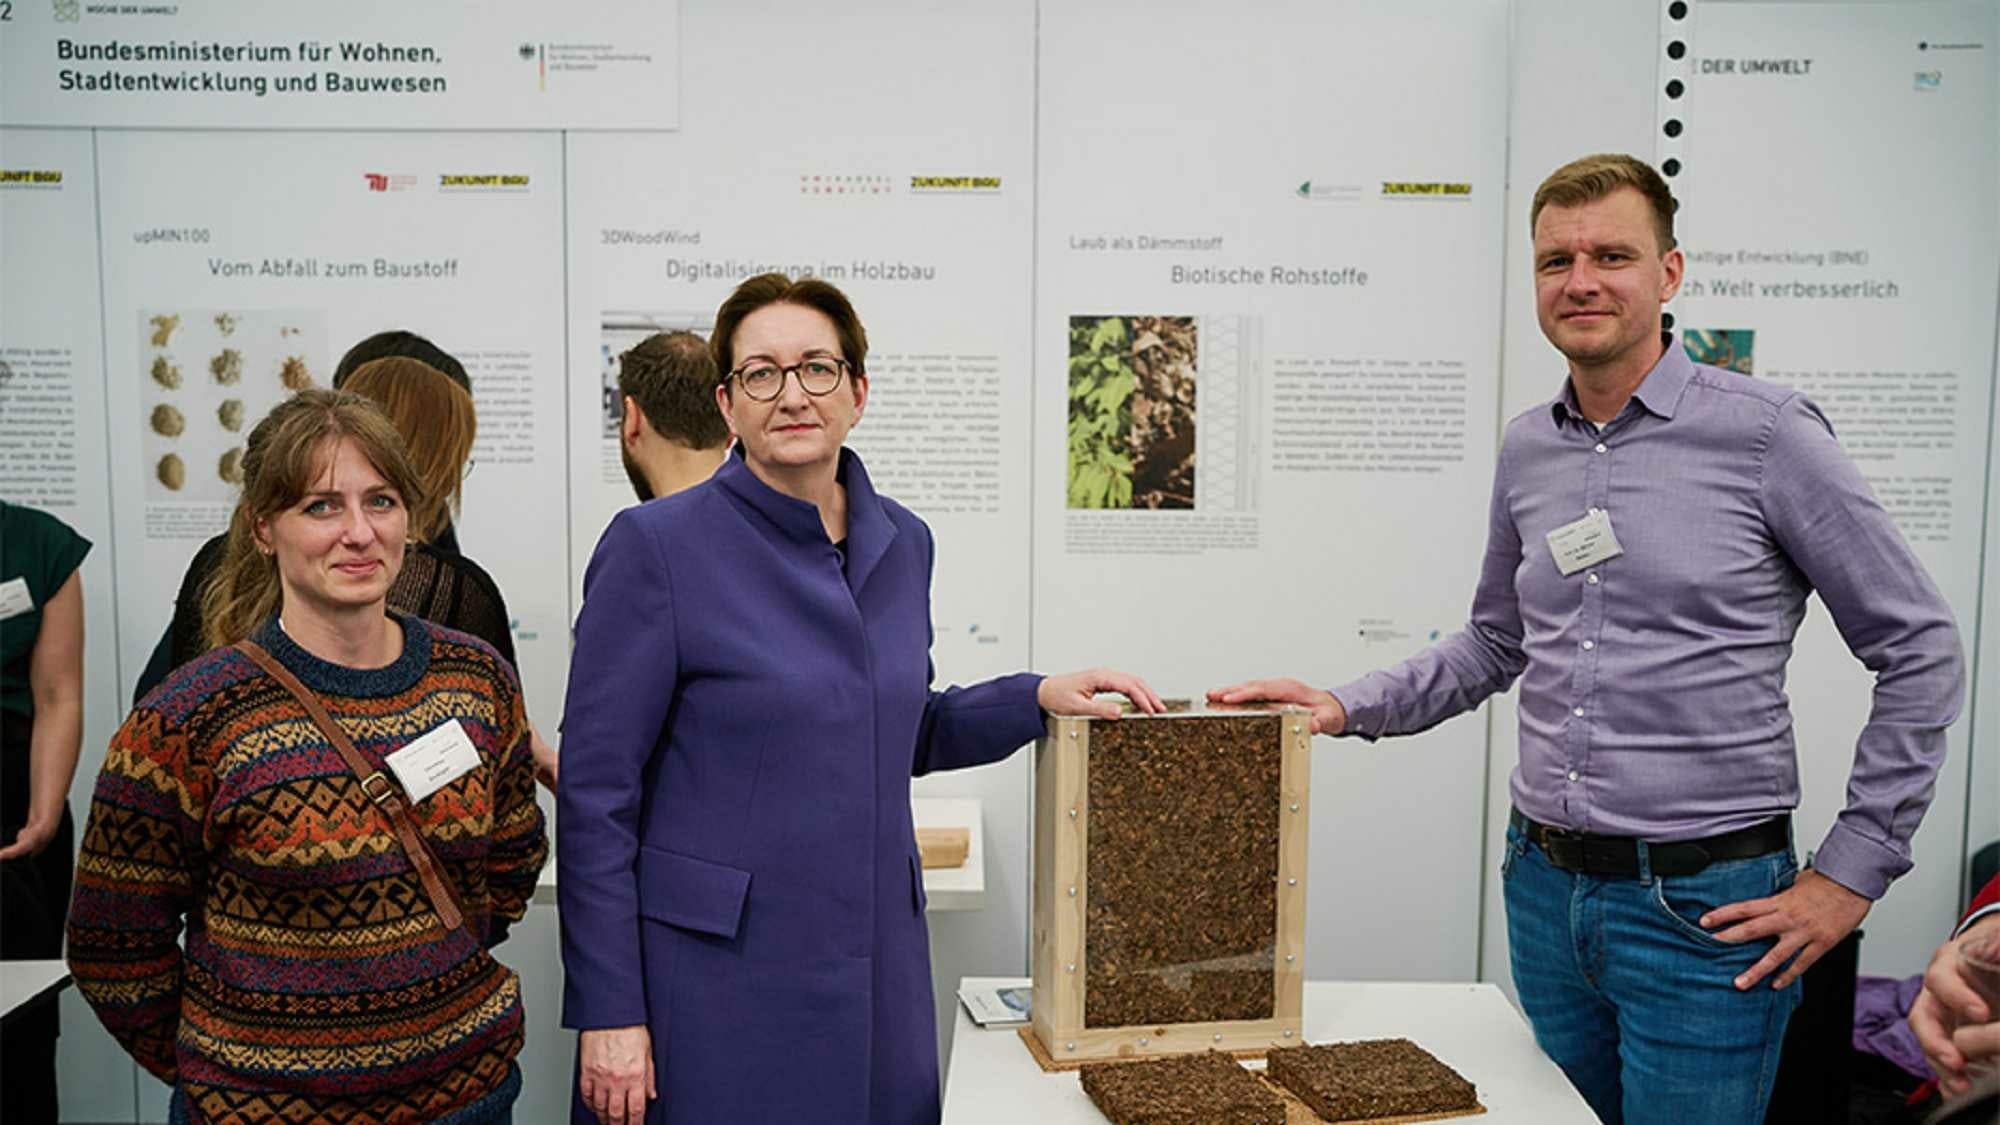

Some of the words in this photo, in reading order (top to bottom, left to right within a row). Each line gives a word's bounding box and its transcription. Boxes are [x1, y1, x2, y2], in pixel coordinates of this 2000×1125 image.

[57, 39, 291, 62] Bundesministerium
[298, 41, 332, 62] für
[339, 42, 442, 64] Wohnen,
[1702, 59, 1735, 74] DER
[1741, 59, 1812, 75] UMWELT
[59, 69, 267, 96] Stadtentwicklung
[274, 73, 318, 92] und
[325, 72, 447, 92] Bauwesen
[1069, 235, 1107, 249] Laub
[1112, 235, 1134, 249] als
[208, 258, 253, 276] Vom
[261, 258, 318, 276] Abfall
[325, 263, 367, 277] zum
[373, 258, 458, 277] Baustoff
[1737, 252, 1824, 266] Entwicklung
[820, 261, 846, 278] im
[852, 261, 936, 280] Holzbau
[1171, 265, 1264, 284] Biotische
[1270, 266, 1368, 285] Rohstoffe
[1711, 279, 1755, 297] Welt
[1760, 280, 1898, 298] verbesserlich
